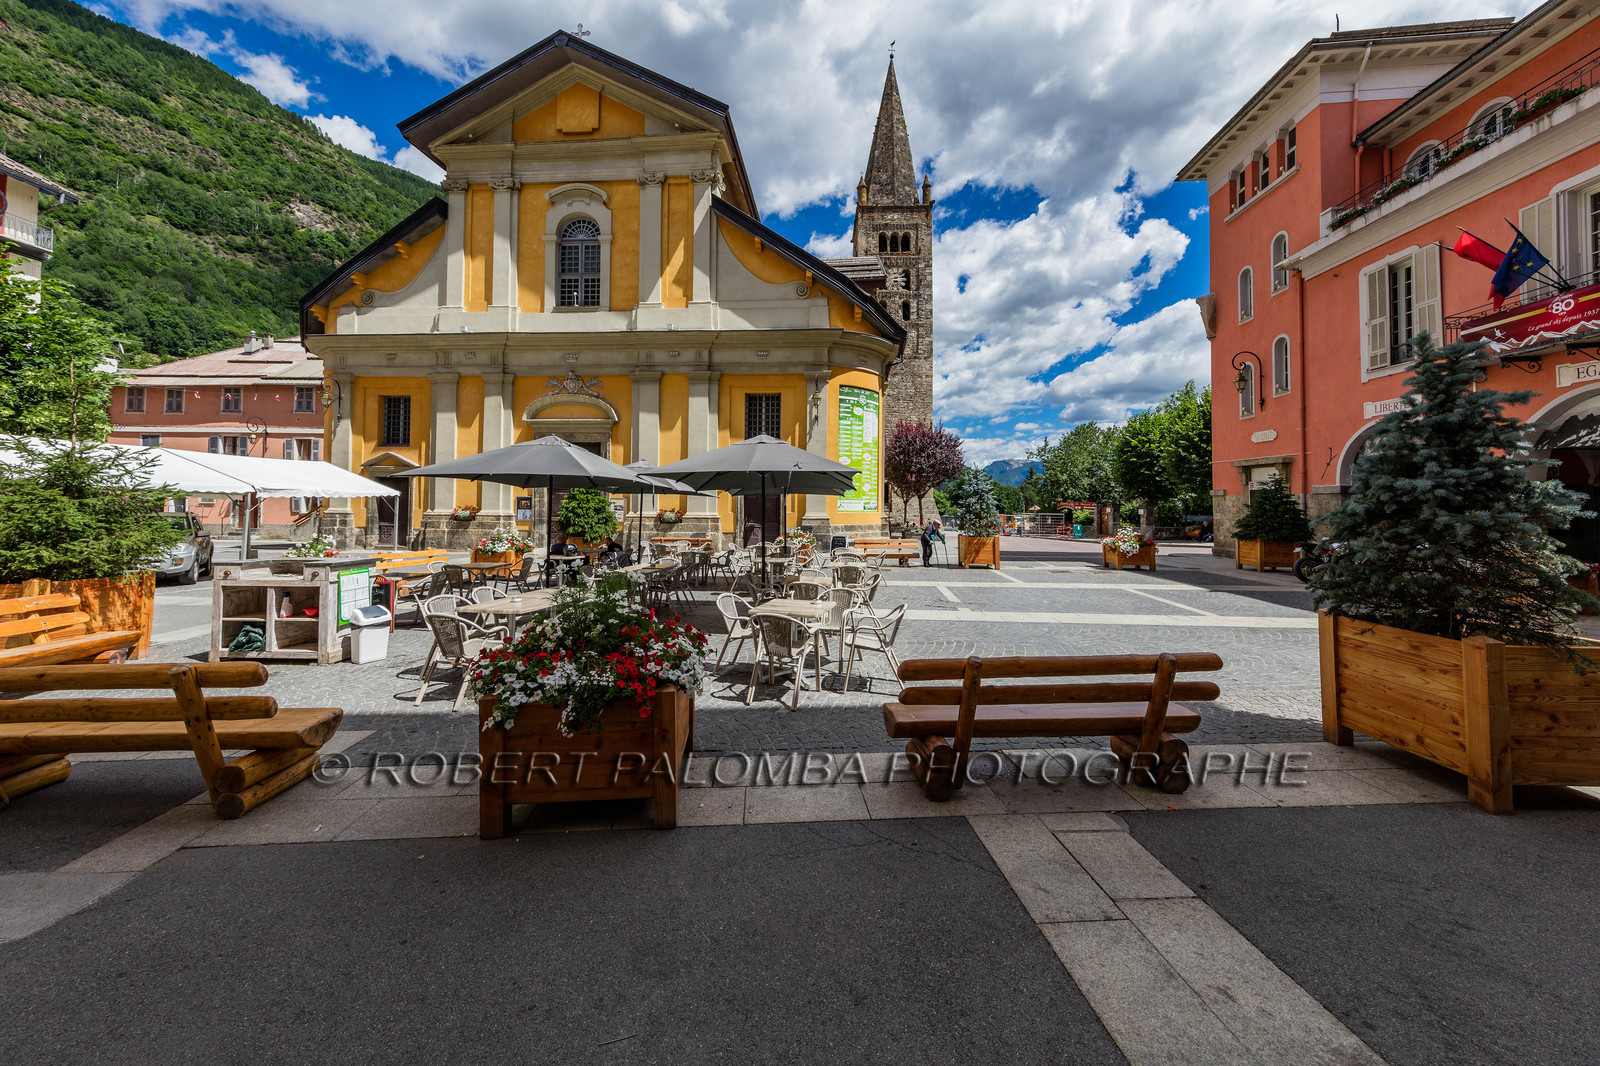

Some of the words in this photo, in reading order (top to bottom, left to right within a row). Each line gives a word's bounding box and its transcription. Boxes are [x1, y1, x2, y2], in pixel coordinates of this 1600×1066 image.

[1552, 299, 1575, 314] 80
[1535, 320, 1553, 331] grand
[1553, 317, 1561, 325] ski
[1562, 313, 1582, 323] depuis
[1584, 308, 1600, 317] 1937
[1576, 364, 1600, 379] EG
